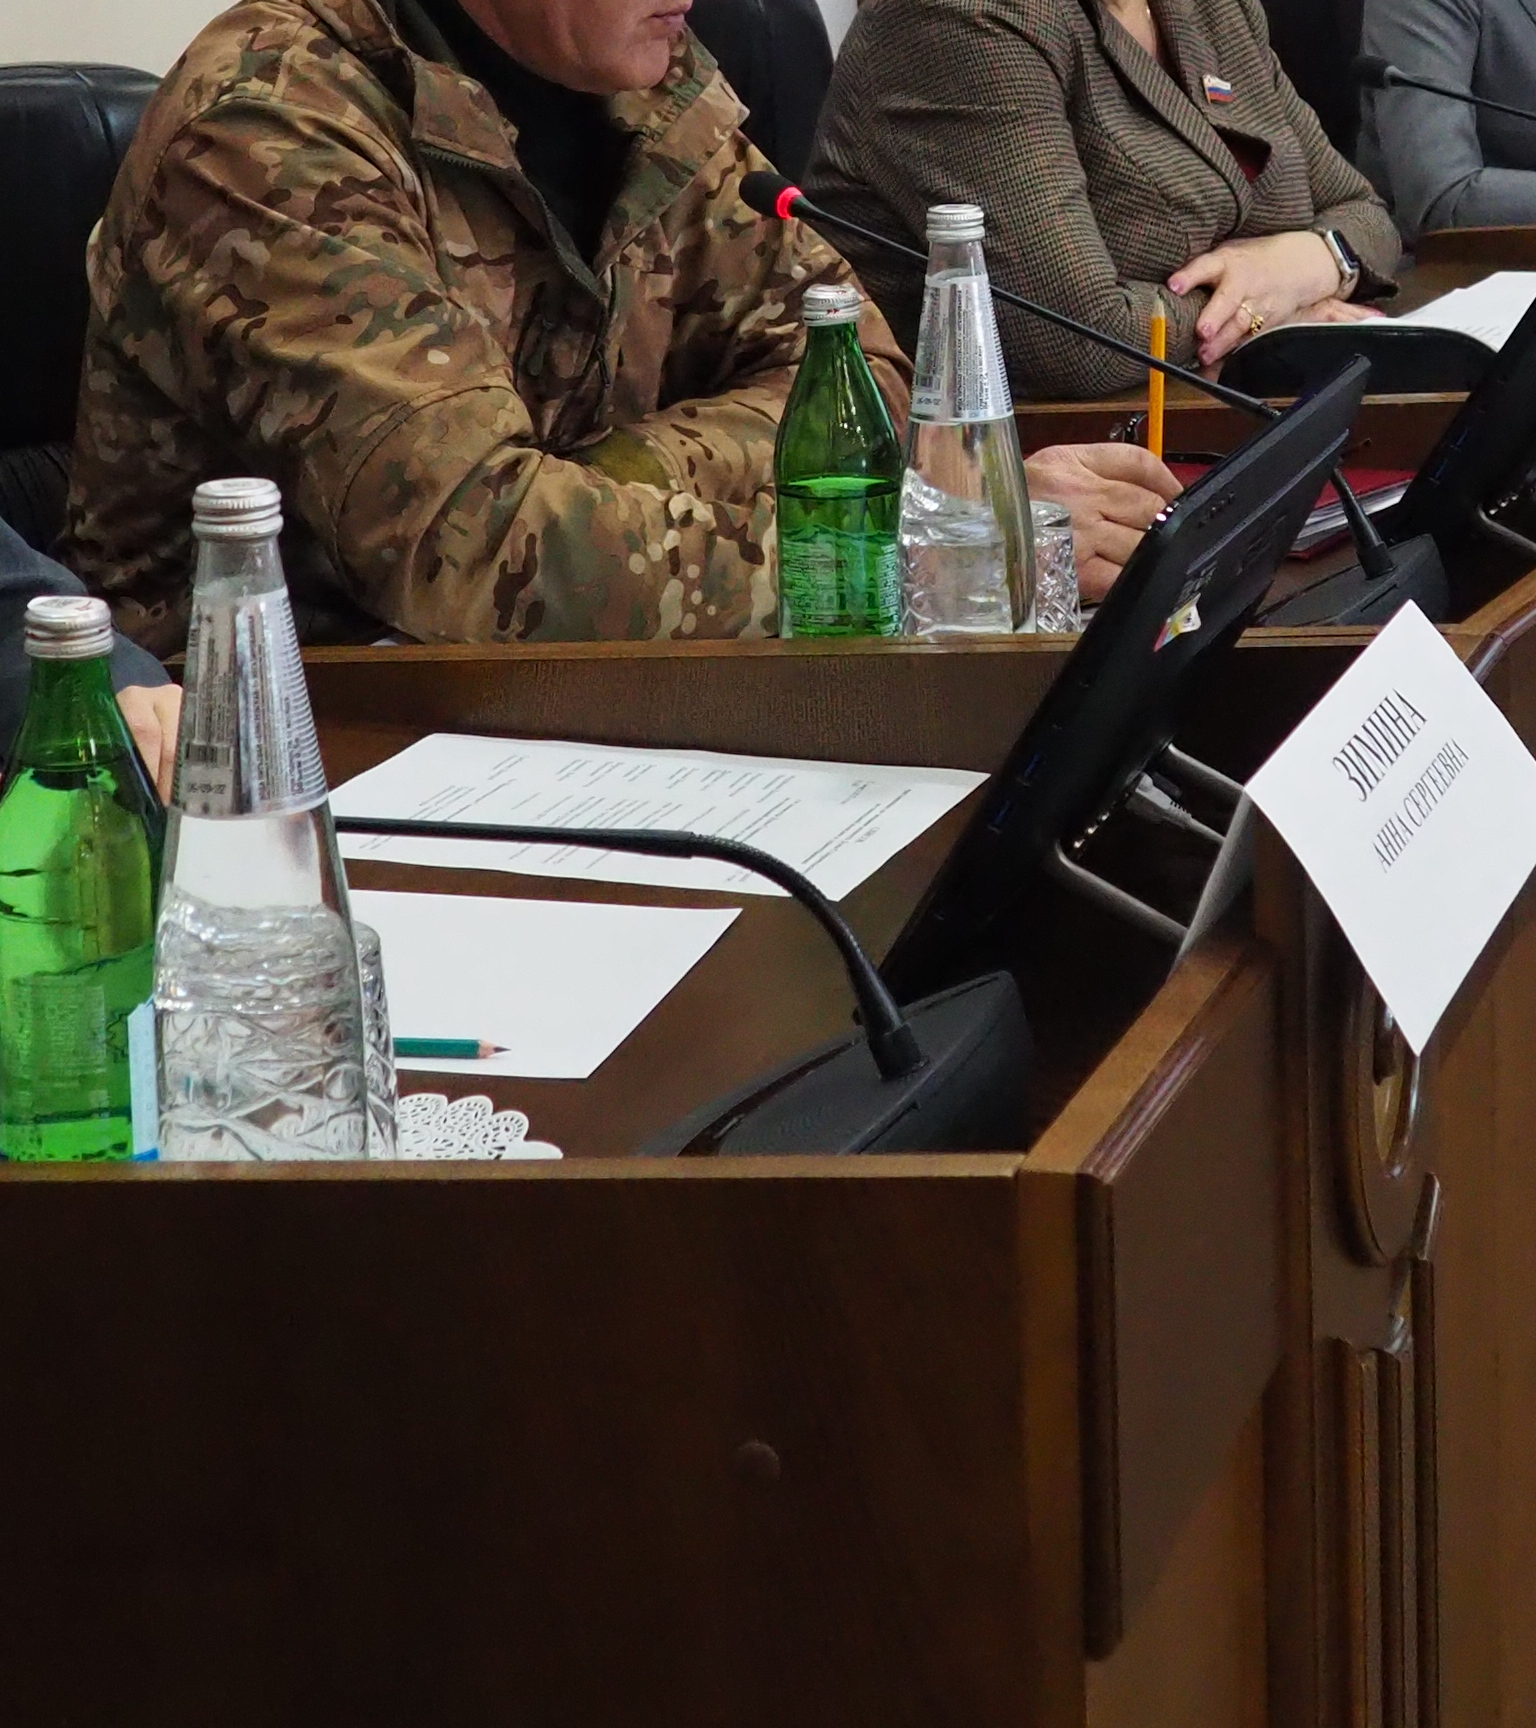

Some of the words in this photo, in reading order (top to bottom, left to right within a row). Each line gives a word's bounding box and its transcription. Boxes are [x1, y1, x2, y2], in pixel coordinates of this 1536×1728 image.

[1332, 687, 1427, 803] ЗИМИНА
[1372, 812, 1414, 874] АННА
[1403, 738, 1469, 828] СЕРГЕЕВНА
